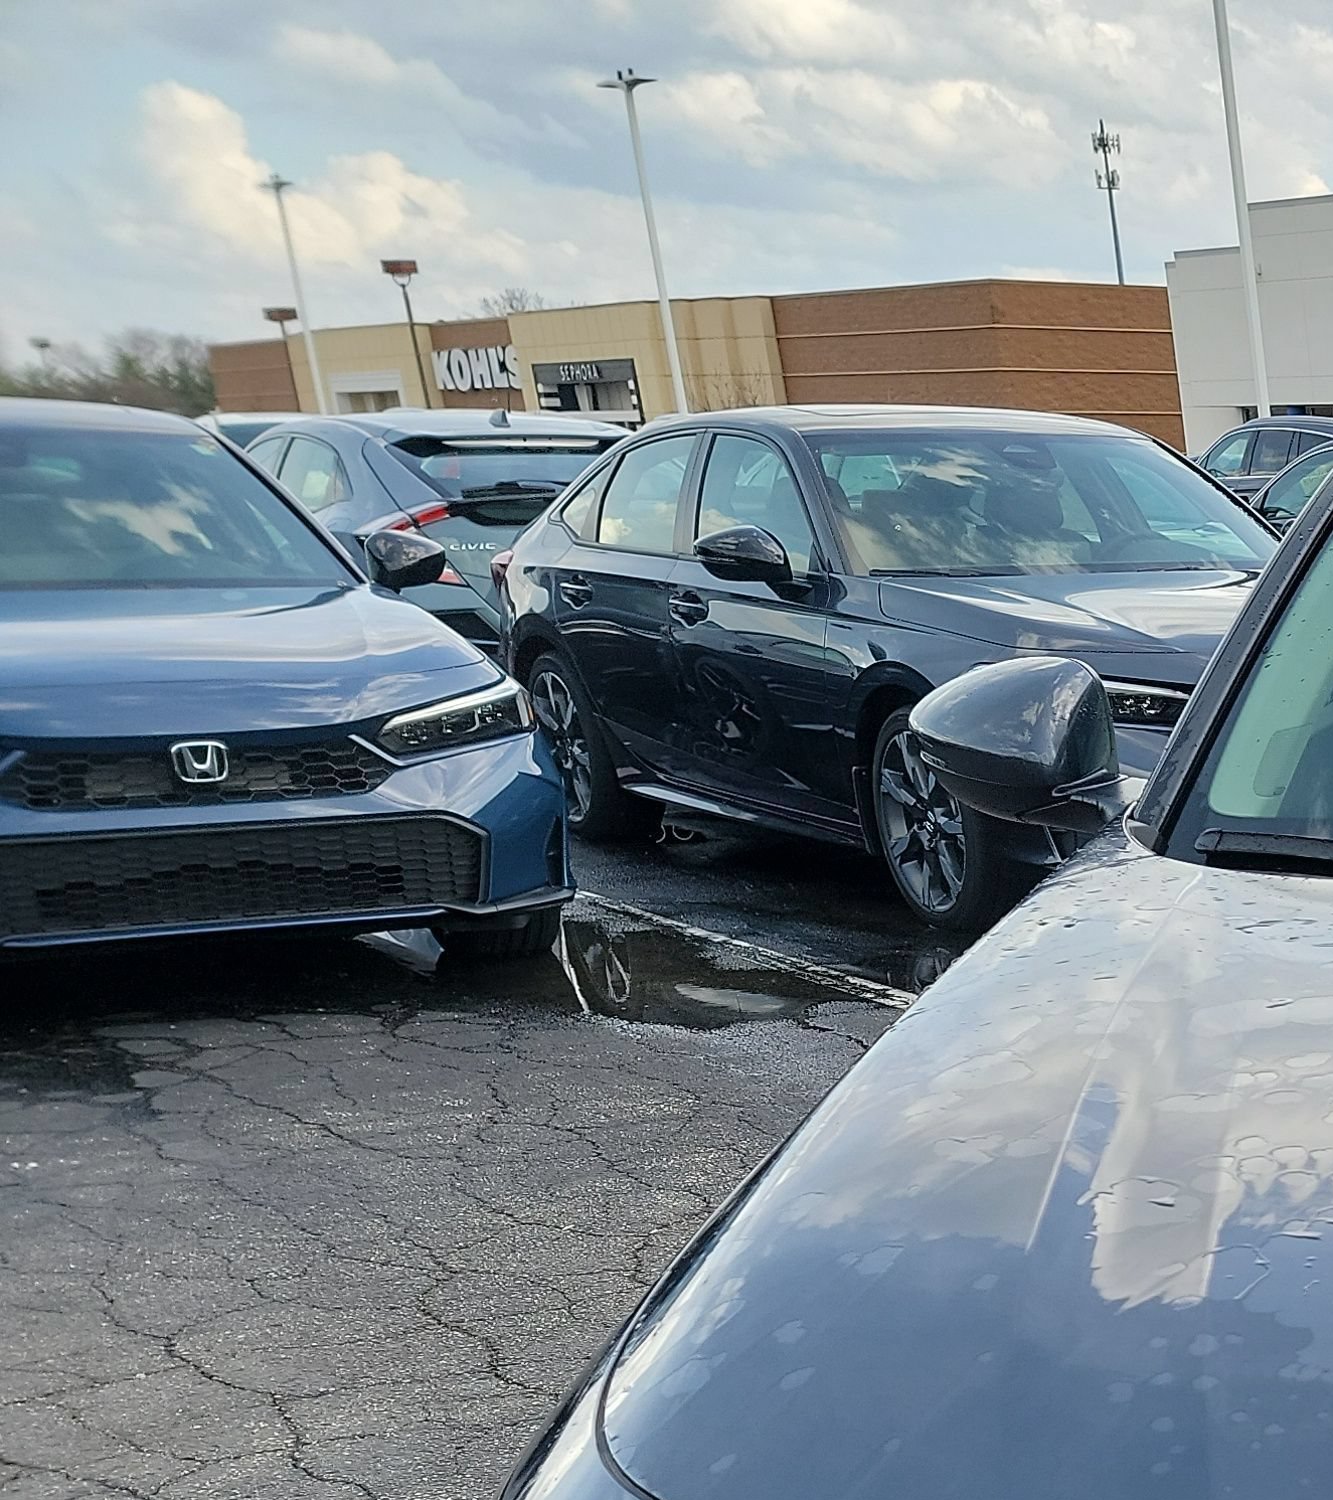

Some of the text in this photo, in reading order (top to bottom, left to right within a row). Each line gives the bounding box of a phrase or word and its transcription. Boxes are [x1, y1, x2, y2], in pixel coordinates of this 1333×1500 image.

[431, 345, 521, 391] KOHL'S
[559, 364, 600, 381] SEPHORA
[450, 542, 497, 550] CIVIC
